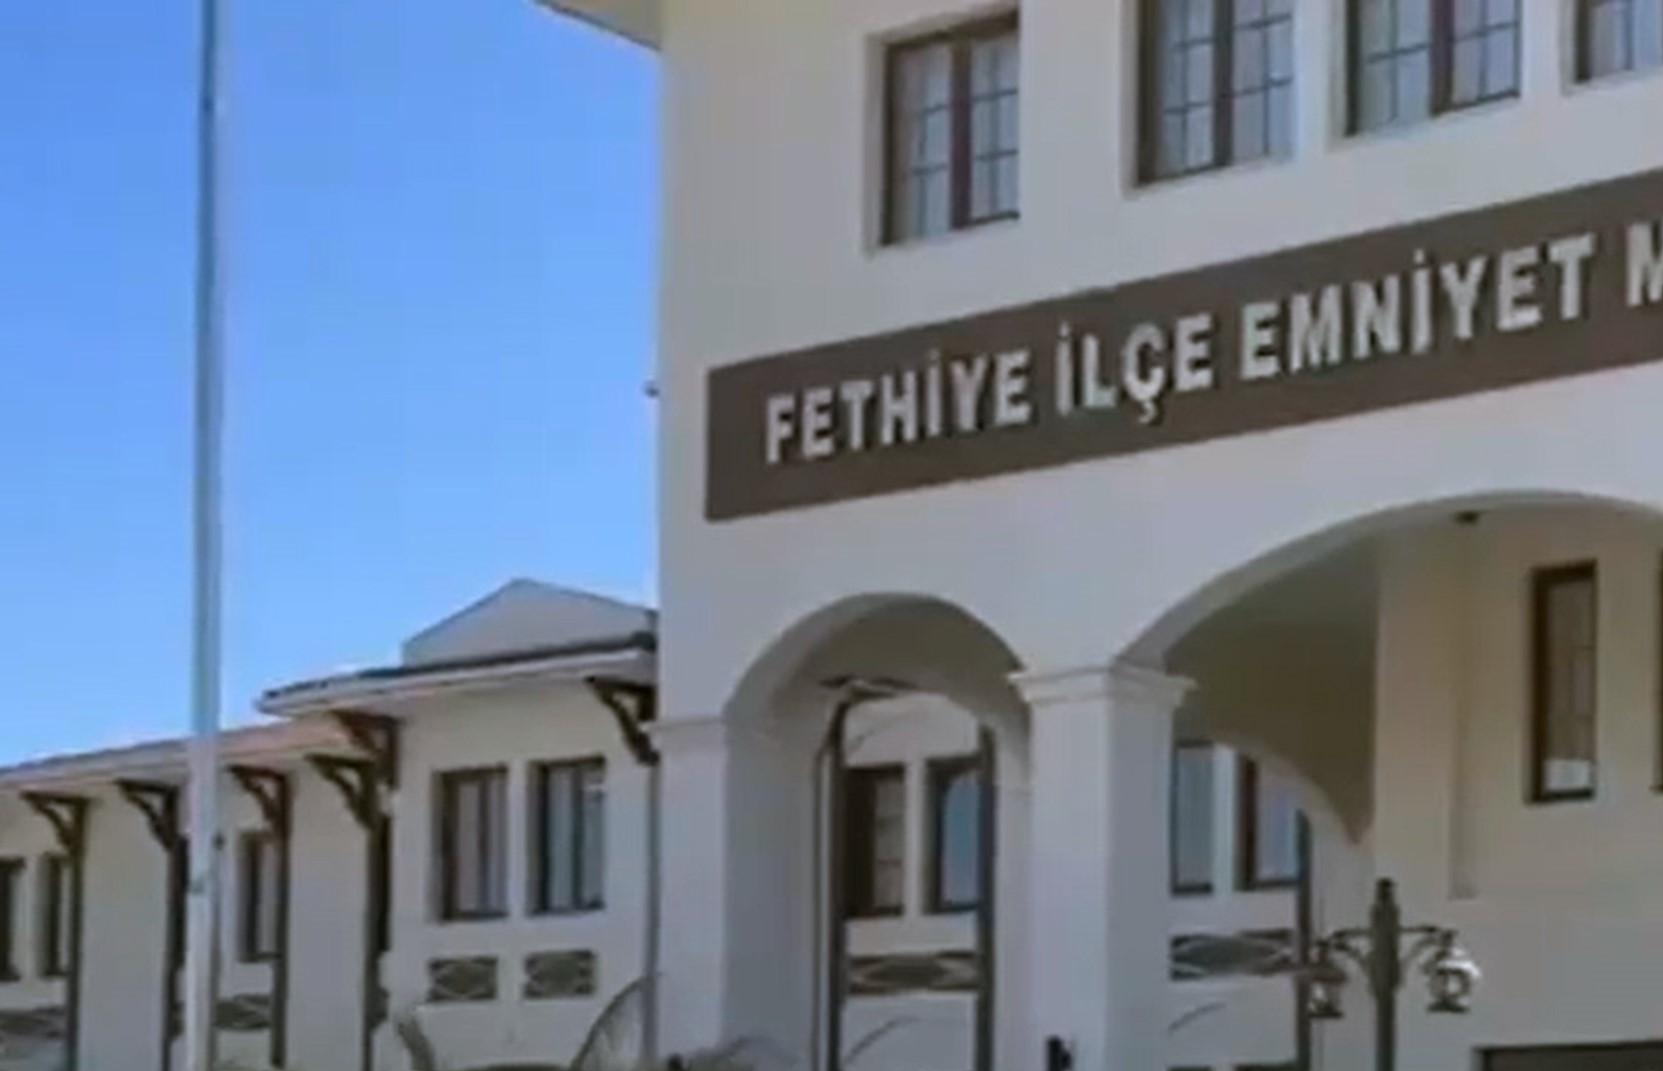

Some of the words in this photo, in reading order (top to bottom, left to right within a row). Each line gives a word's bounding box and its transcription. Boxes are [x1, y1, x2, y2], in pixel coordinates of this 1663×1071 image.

[764, 347, 1033, 466] FETHİYE
[1055, 313, 1215, 424] İLÇE
[1240, 234, 1595, 379] EMNİYET
